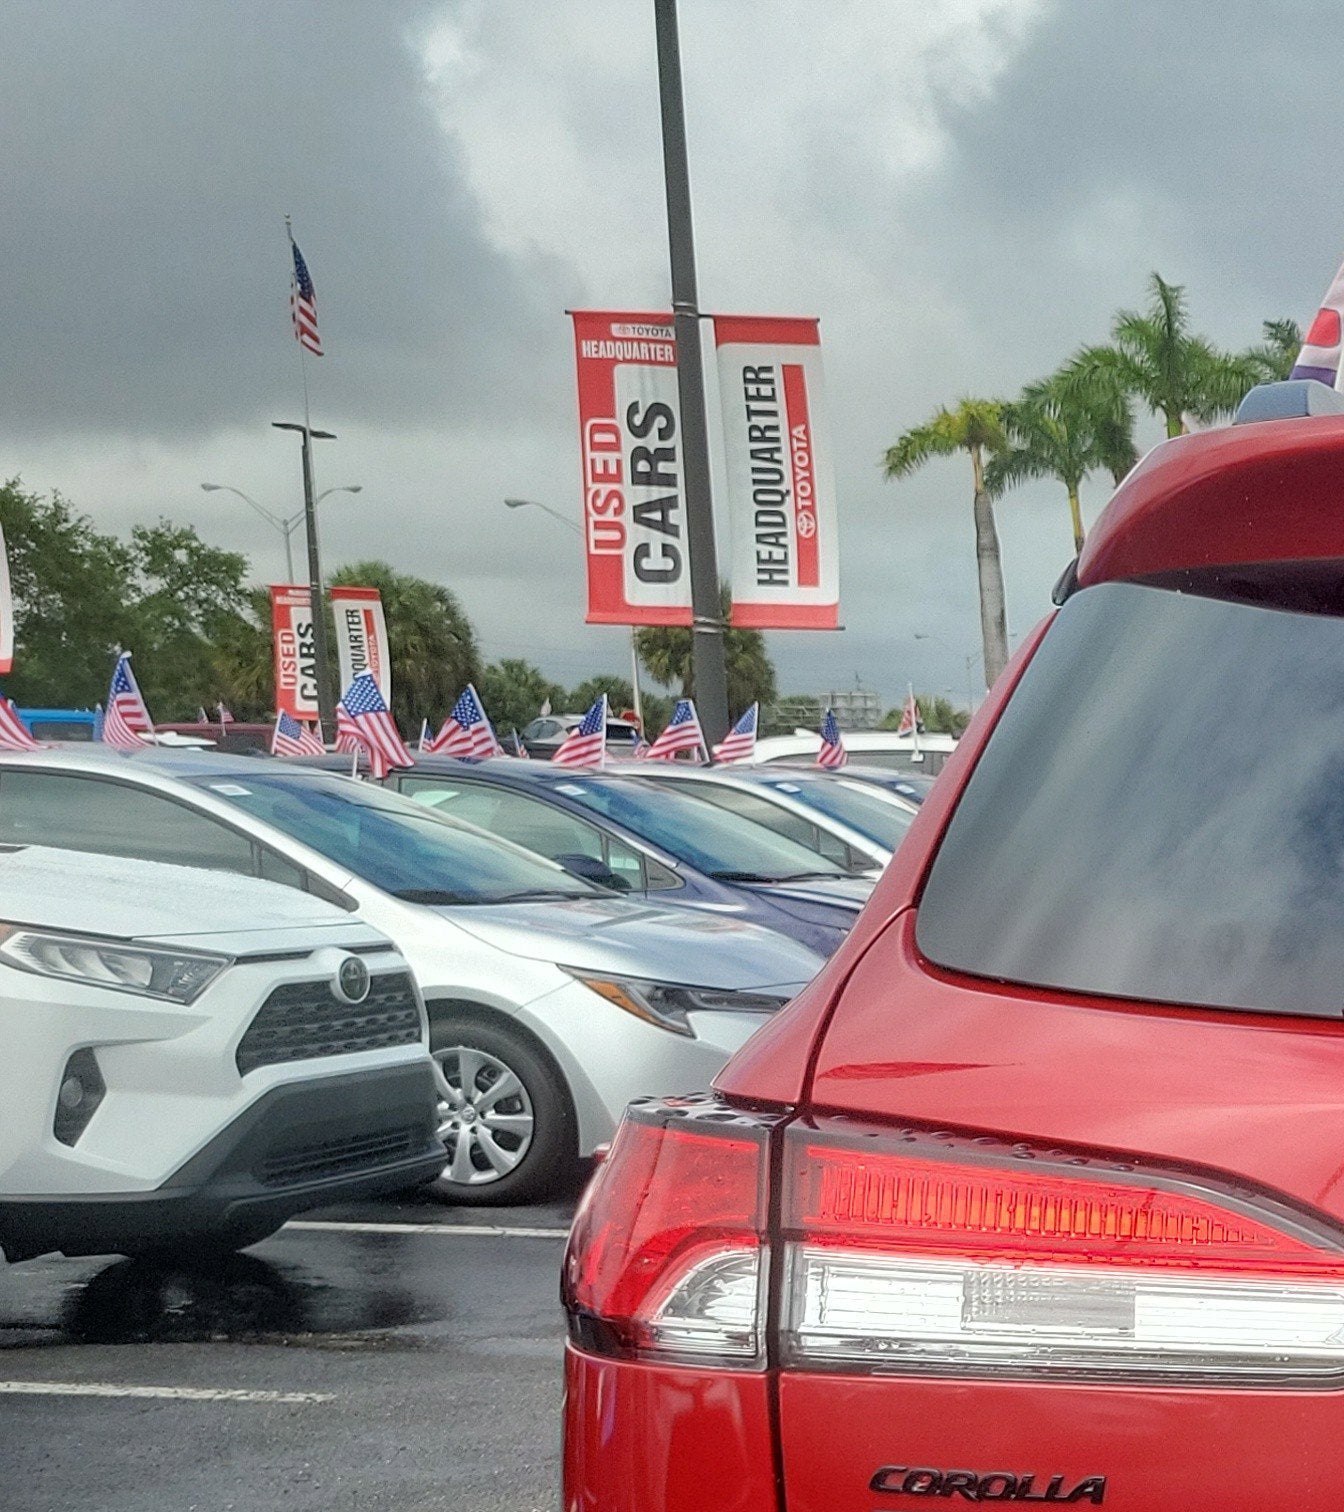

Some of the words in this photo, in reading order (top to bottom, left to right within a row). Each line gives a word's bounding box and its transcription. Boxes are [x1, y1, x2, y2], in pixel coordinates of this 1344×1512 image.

[582, 340, 674, 362] HEADQUARTER
[631, 326, 672, 338] TOYOTA
[586, 418, 627, 555] USED
[626, 400, 683, 585] CARS
[742, 365, 791, 587] HEADQUARTER
[791, 424, 815, 510] TOYOTA
[281, 631, 297, 687] USED
[297, 622, 318, 700] CARS
[345, 608, 368, 680] QUARTER
[868, 1465, 1106, 1505] COROLLA
